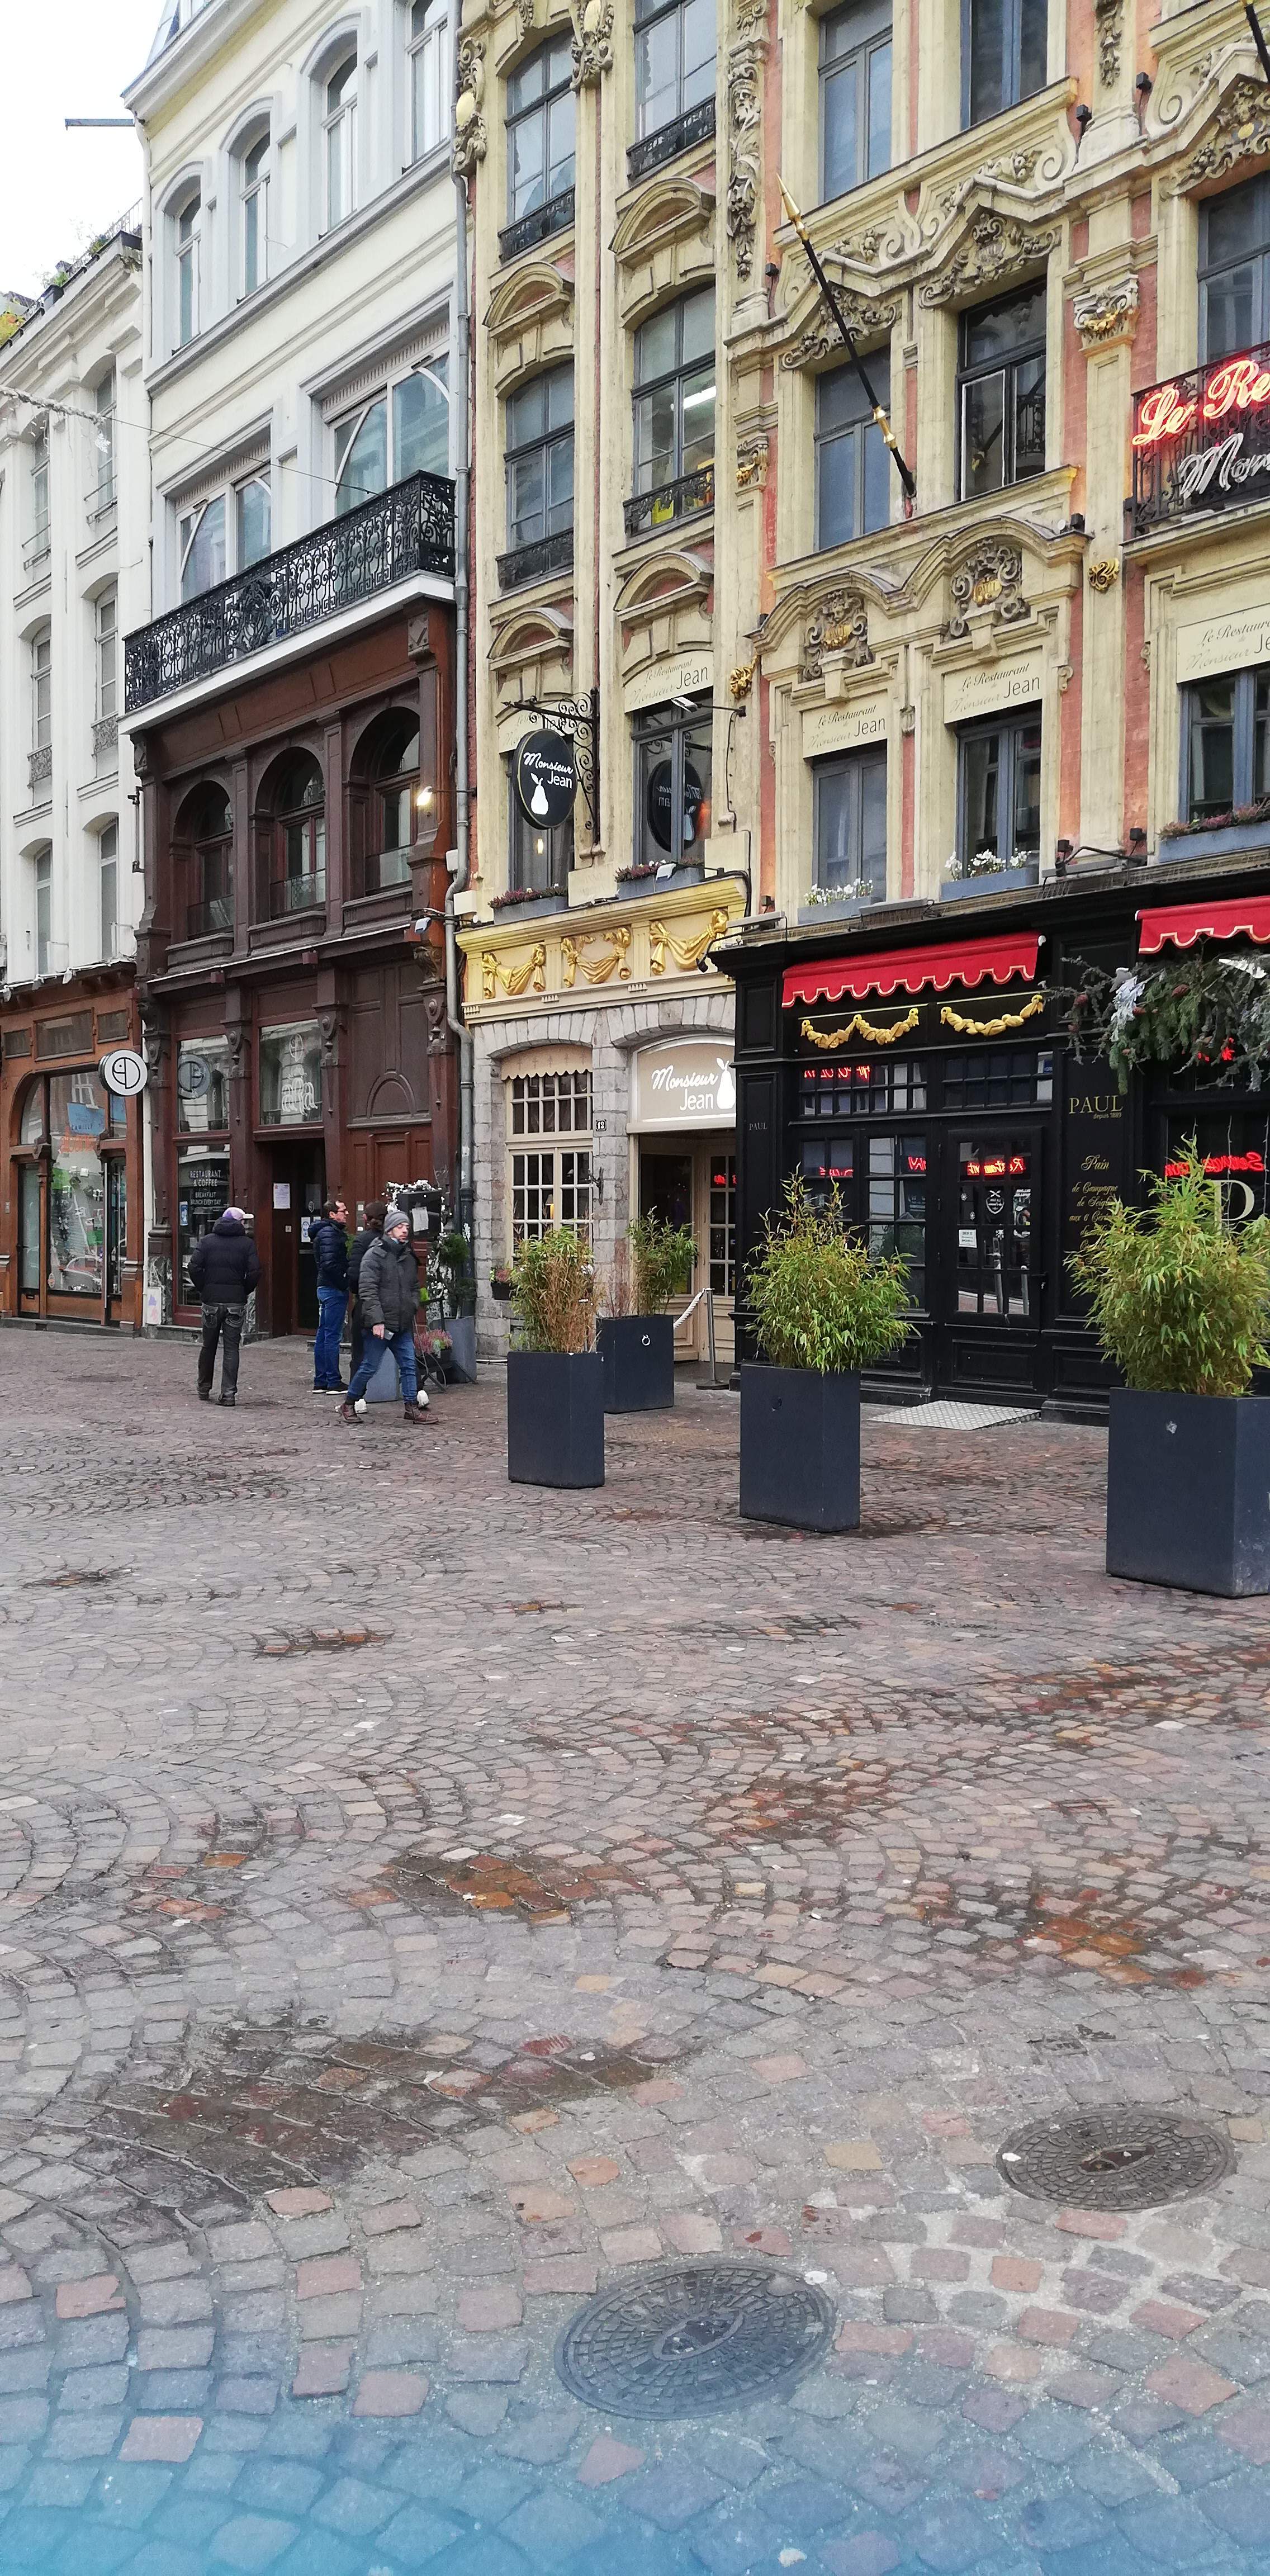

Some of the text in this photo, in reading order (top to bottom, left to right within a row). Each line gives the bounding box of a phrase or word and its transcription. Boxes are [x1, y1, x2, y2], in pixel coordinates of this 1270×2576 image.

[1132, 387, 1198, 445] Le
[1197, 628, 1214, 647] Le
[654, 659, 692, 678] Restaurant
[1186, 649, 1249, 670] Monsieur
[676, 666, 708, 689] Jean
[959, 663, 1029, 692] Le Restaurant
[950, 677, 1040, 713] Monsieur Jean
[815, 705, 876, 729] Le Restaurant
[808, 718, 885, 749] Monsieur Jean
[523, 752, 574, 774] Monsieur
[547, 771, 572, 789] Jean
[651, 1065, 719, 1092] Monsieur
[679, 1088, 714, 1111] Jean
[1069, 1095, 1124, 1114] PAUL
[598, 1121, 605, 1129] 12
[749, 1122, 768, 1130] PAUL
[1081, 1154, 1110, 1171] Pain
[190, 1169, 221, 1178] RESTAURANT
[1072, 1182, 1118, 1195] de Campagne
[1077, 1196, 1111, 1209] de Seigl
